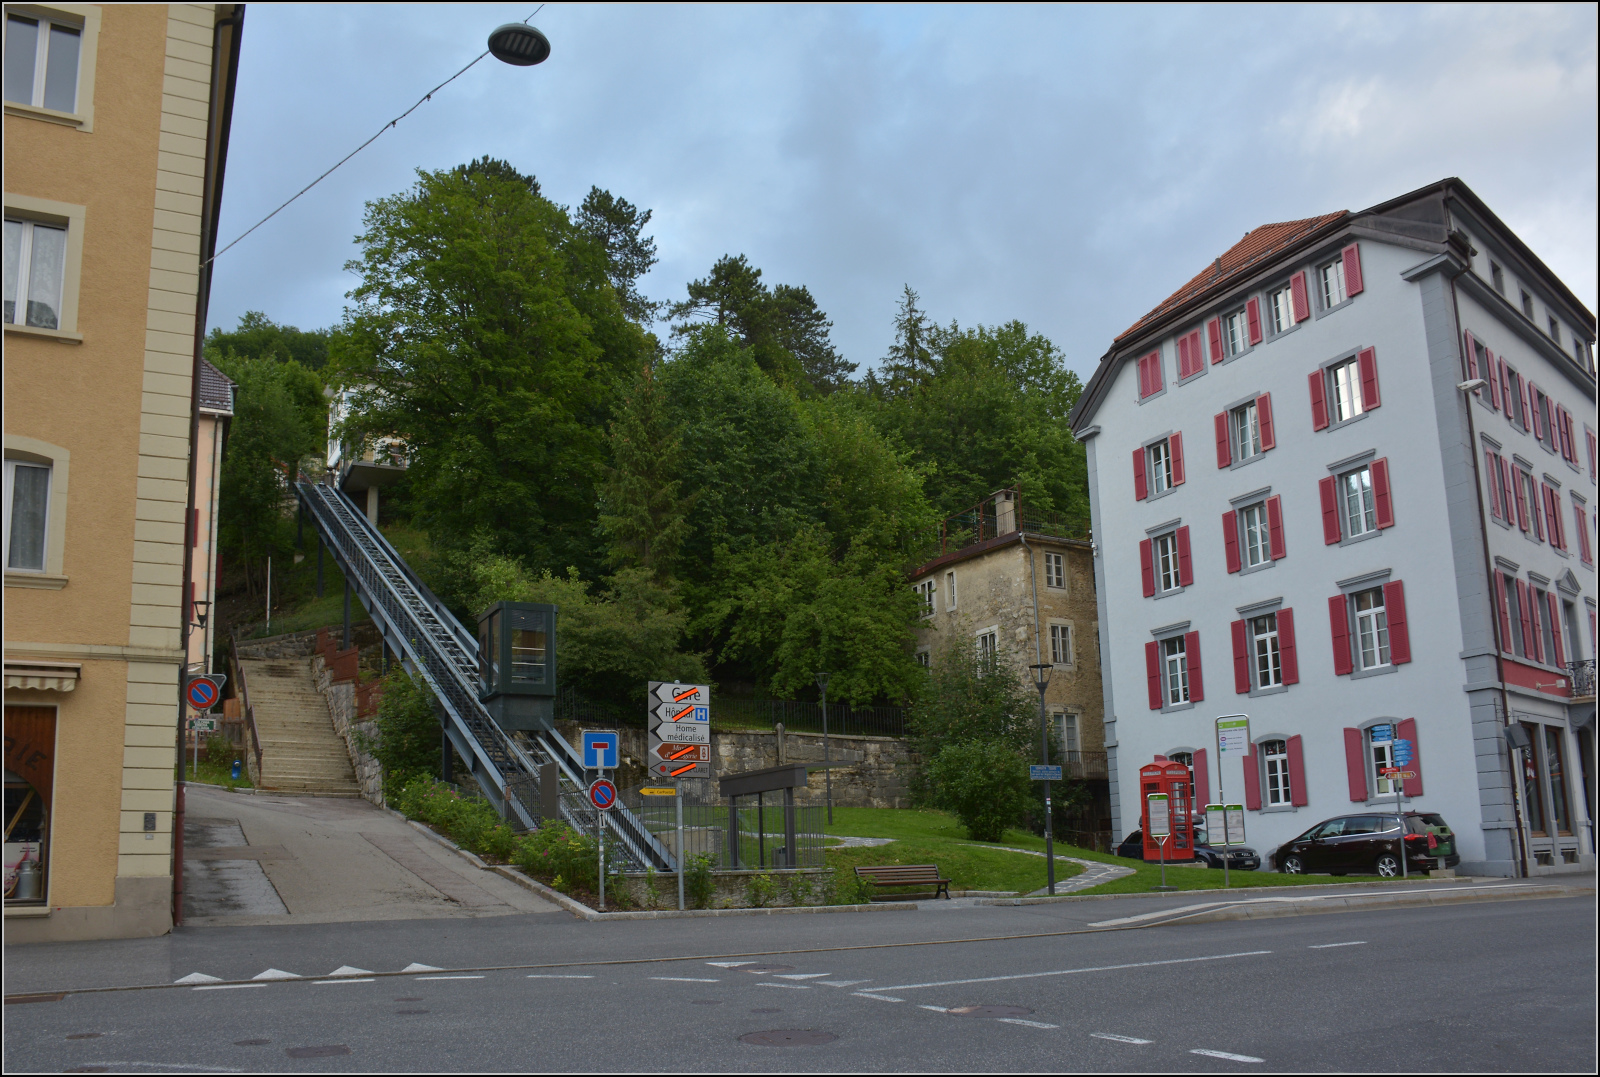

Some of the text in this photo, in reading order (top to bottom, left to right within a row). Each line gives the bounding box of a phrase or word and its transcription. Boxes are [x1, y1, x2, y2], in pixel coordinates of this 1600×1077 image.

[672, 687, 701, 701] Ge
[665, 706, 693, 719] Hôpal
[676, 725, 697, 733] Home
[667, 733, 705, 742] médicalisé
